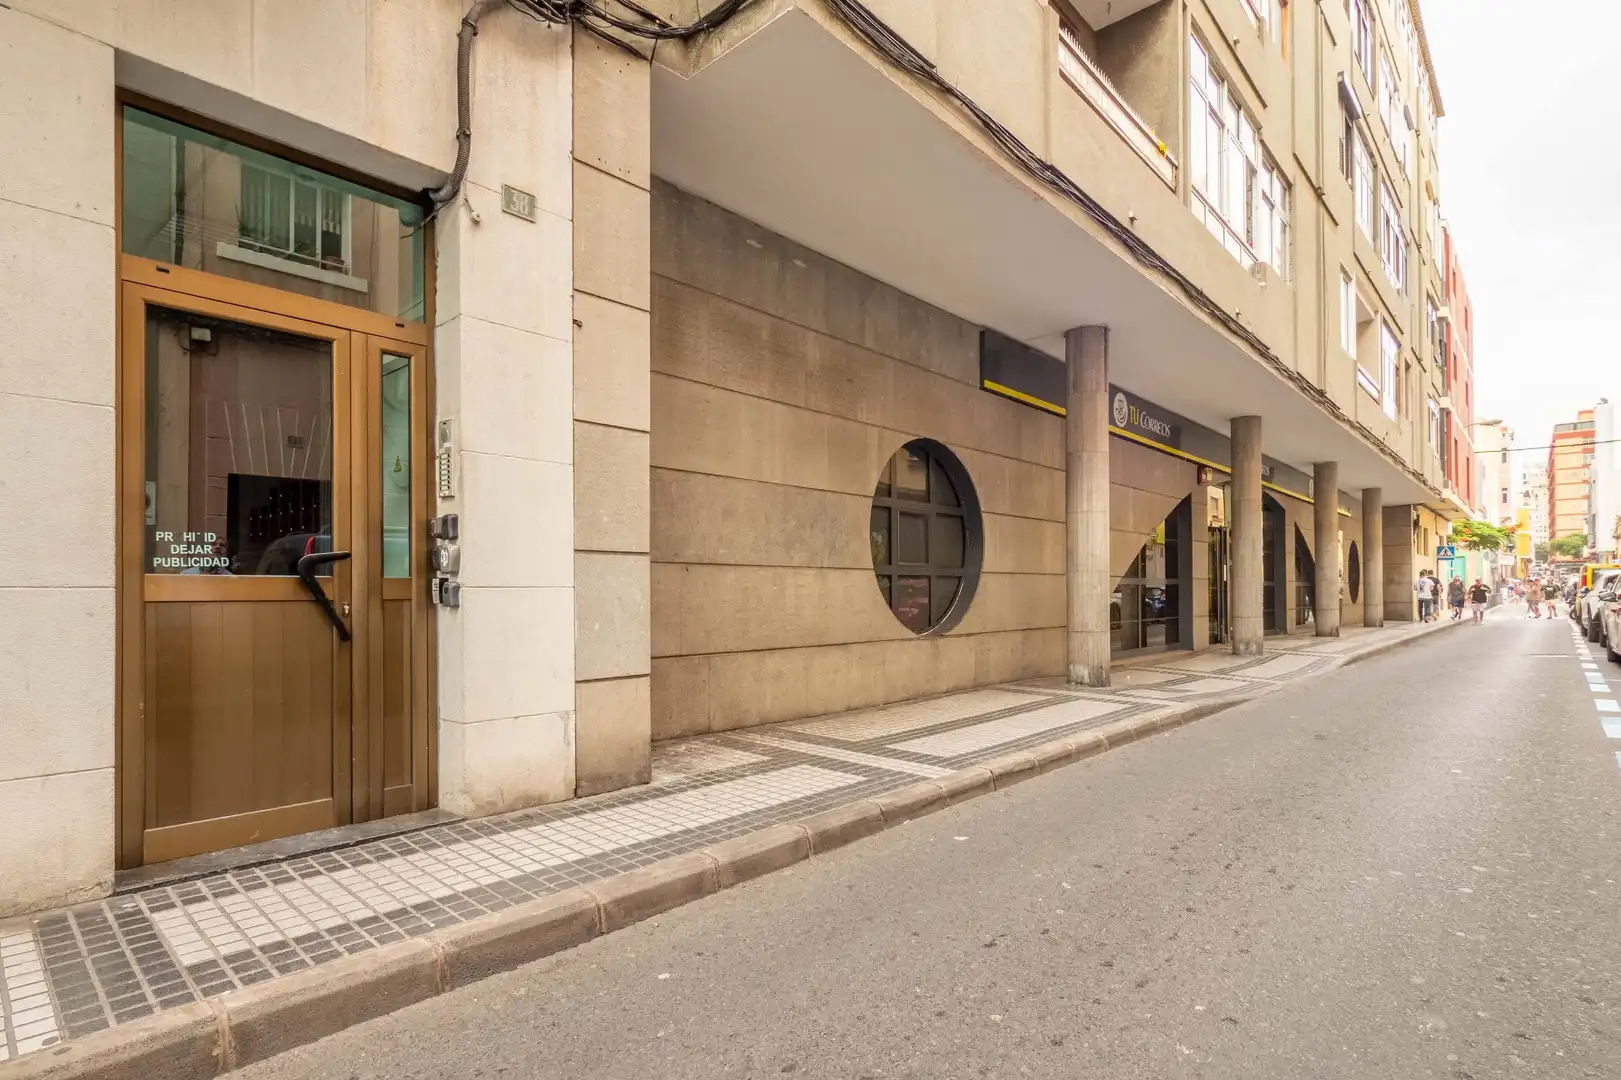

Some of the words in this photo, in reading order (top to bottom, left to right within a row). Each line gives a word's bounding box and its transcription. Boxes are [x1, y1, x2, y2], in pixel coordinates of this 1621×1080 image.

[1129, 405, 1139, 425] TU
[171, 544, 212, 554] DEJAR
[153, 557, 229, 567] PUBLICIDAD
